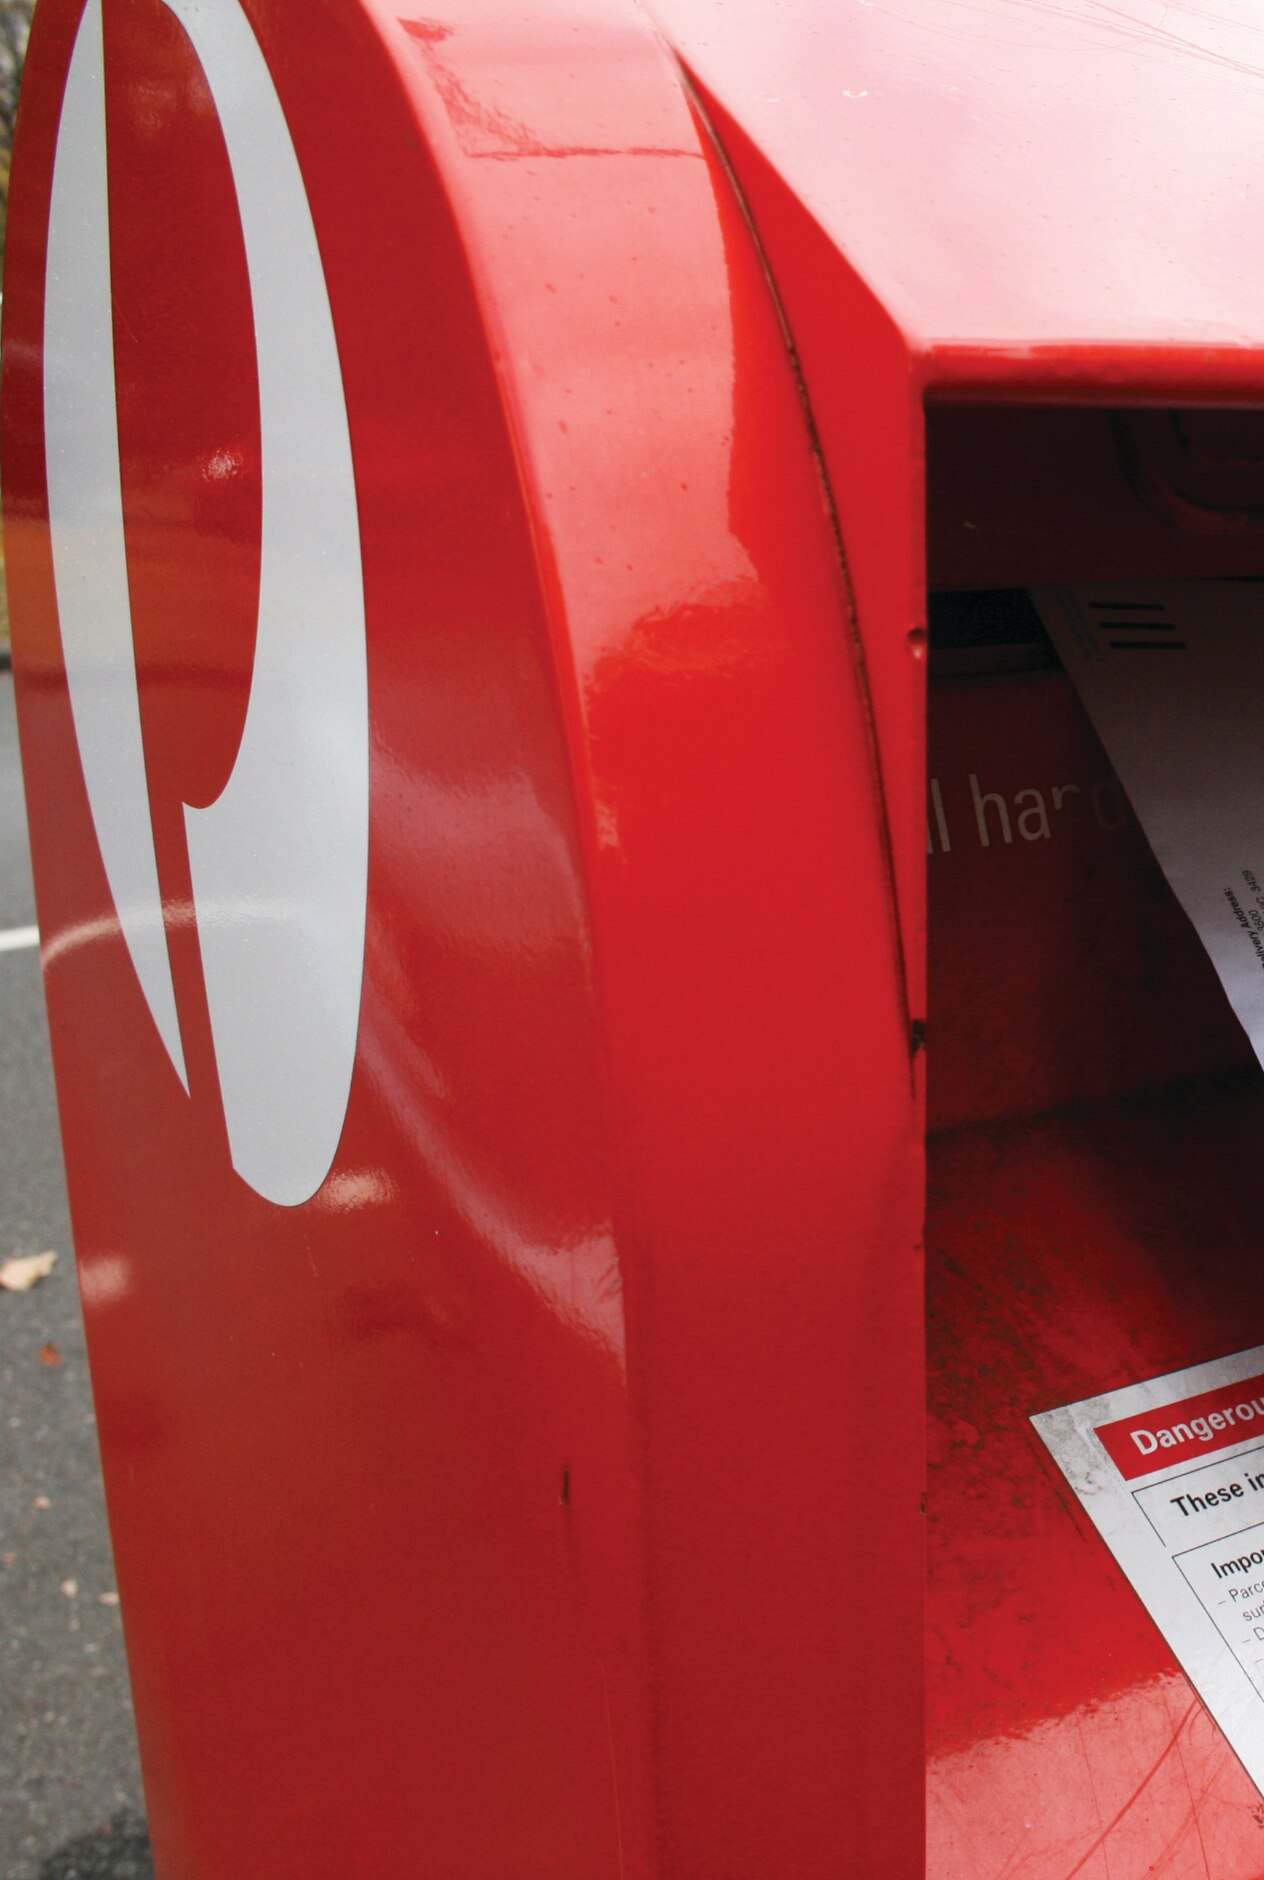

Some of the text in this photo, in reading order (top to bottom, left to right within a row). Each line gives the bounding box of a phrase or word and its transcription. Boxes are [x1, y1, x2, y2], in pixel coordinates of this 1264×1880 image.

[1241, 870, 1261, 892] 3429
[1223, 887, 1252, 929] Address:
[1169, 1483, 1245, 1517] These
